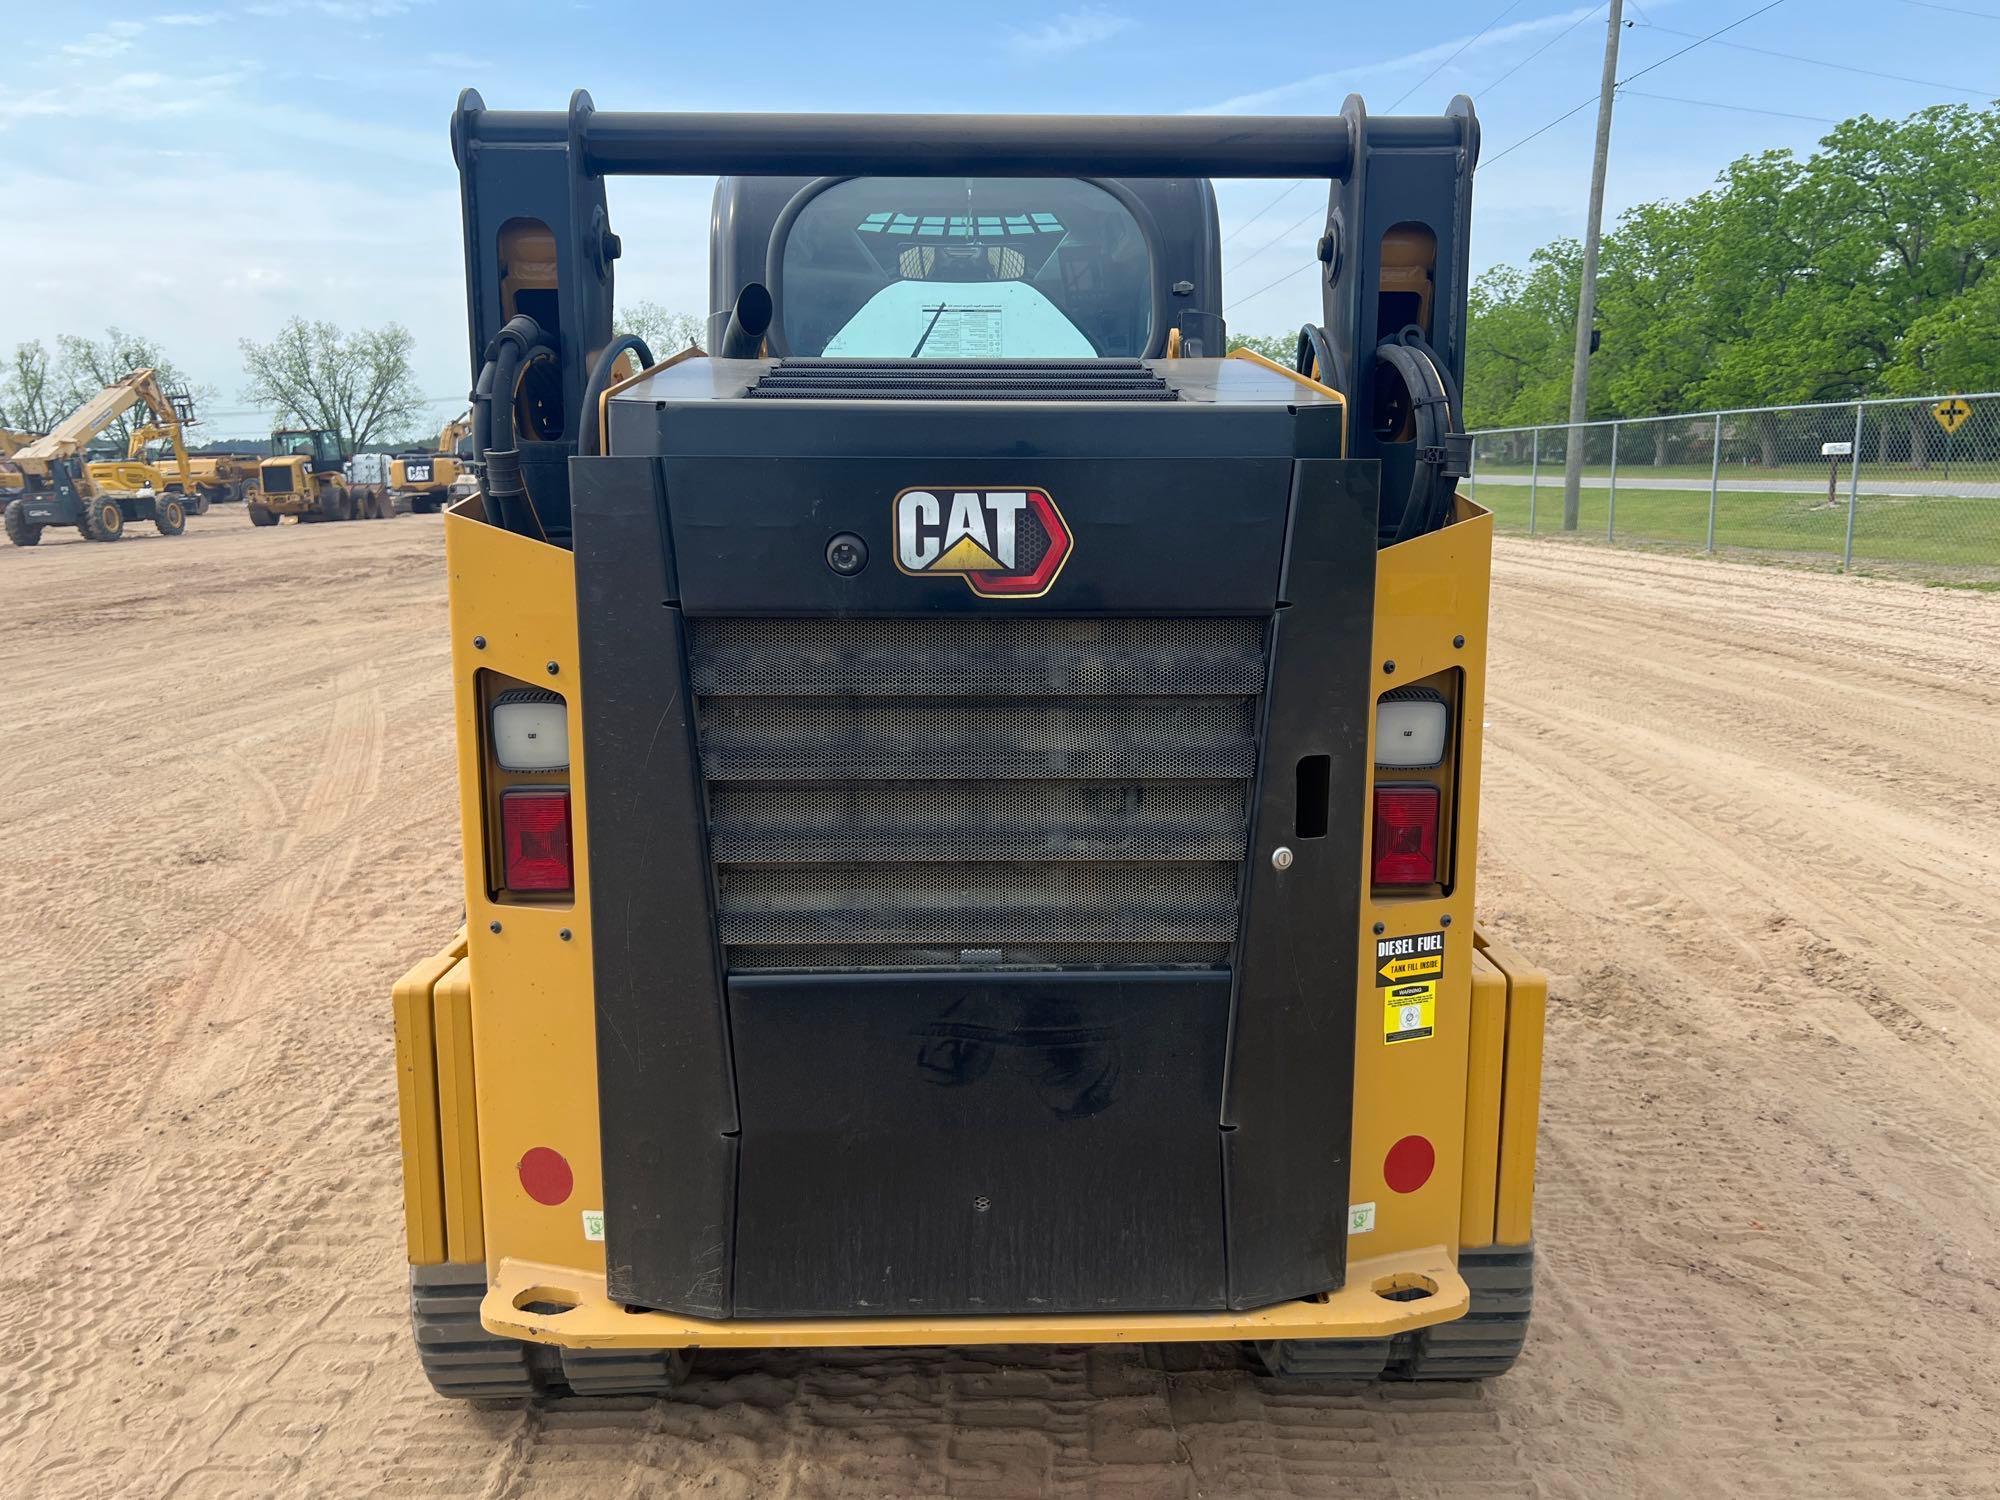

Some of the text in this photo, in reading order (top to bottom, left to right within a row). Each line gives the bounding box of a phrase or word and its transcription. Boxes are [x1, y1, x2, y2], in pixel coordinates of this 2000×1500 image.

[407, 465, 430, 481] CAT
[899, 491, 1027, 570] CAT
[1378, 934, 1442, 957] DIESEL FUEL
[1391, 959, 1438, 973] TANK FILL INSIDE
[1399, 988, 1422, 996] WARNING
